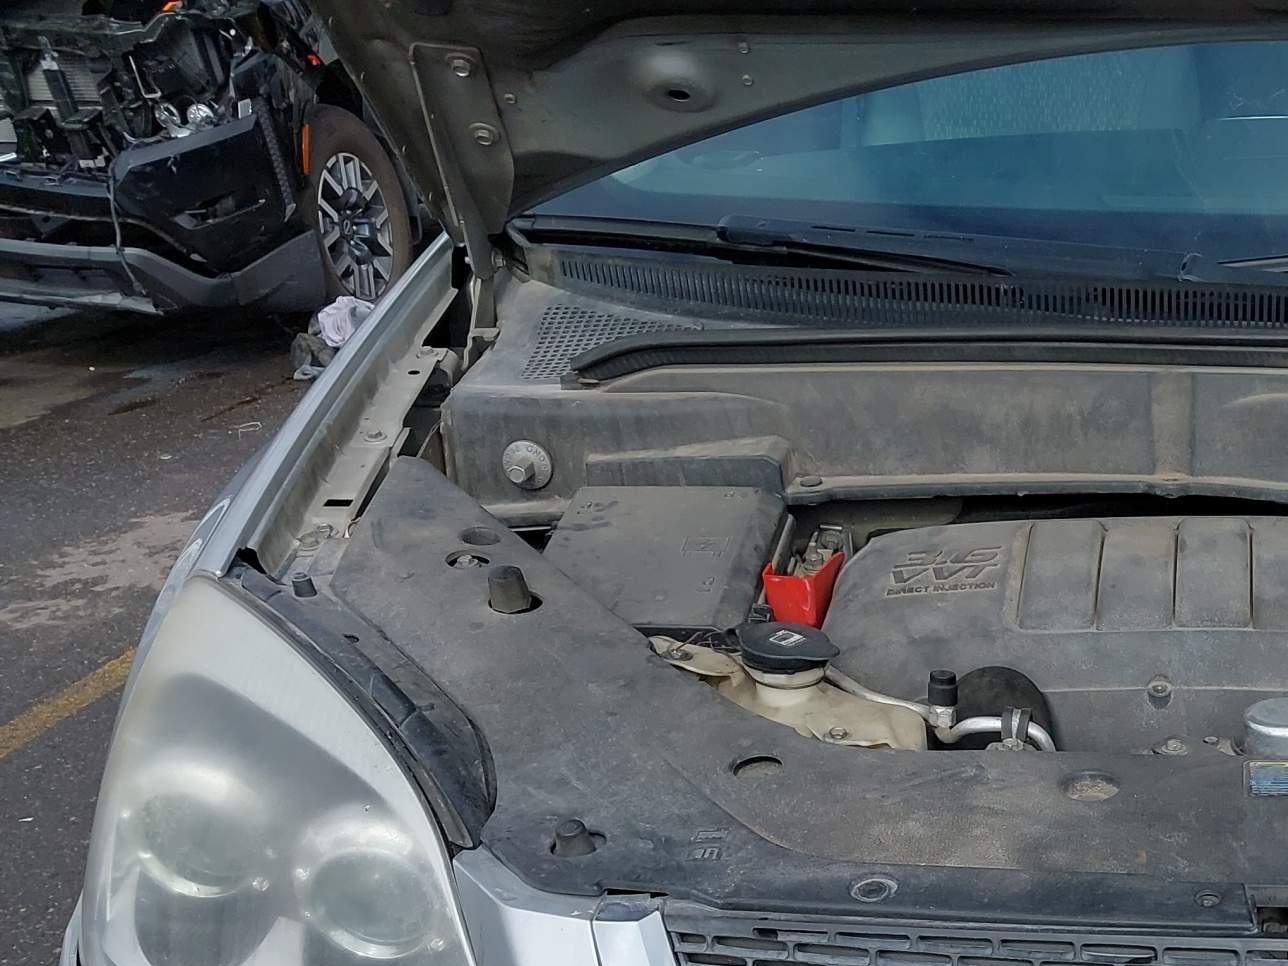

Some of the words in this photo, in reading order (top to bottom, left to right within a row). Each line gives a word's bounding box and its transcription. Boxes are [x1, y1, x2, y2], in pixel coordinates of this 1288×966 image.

[891, 563, 999, 584] VVT
[886, 586, 930, 597] DIRECT
[933, 582, 995, 593] INJECTION
